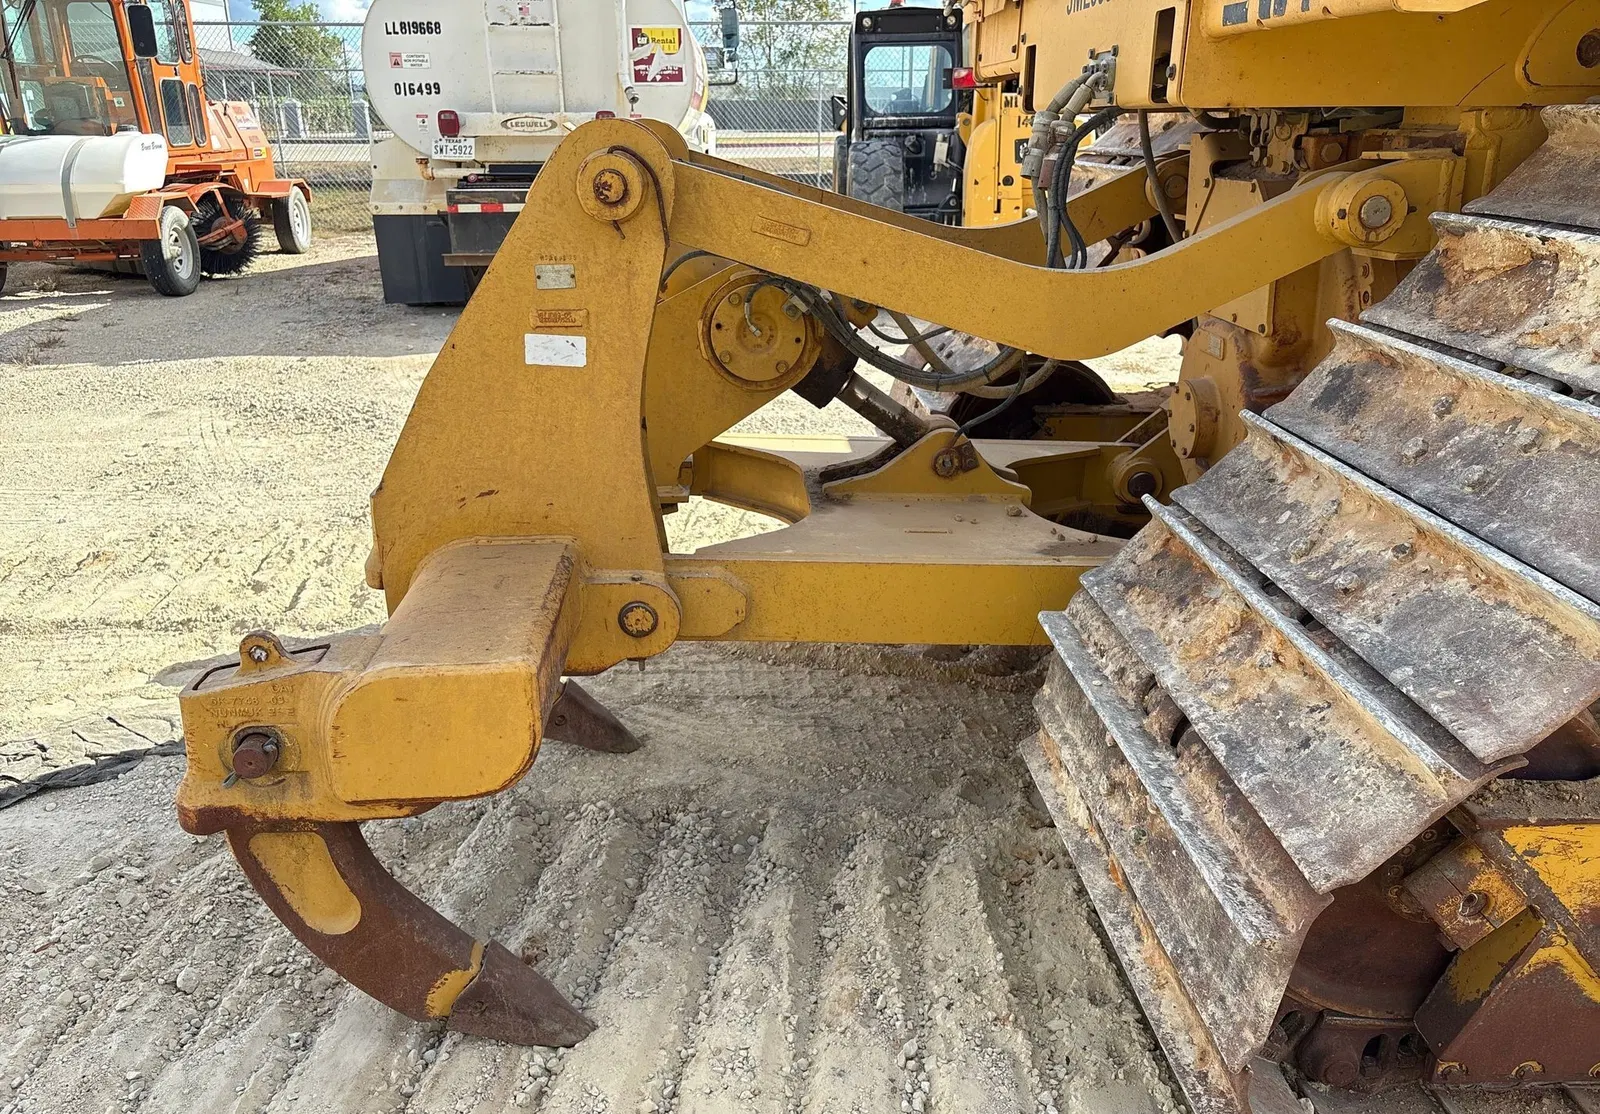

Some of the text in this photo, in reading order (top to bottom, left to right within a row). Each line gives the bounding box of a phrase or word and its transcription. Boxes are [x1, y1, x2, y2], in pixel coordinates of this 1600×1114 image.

[385, 21, 442, 36] LL819668
[651, 37, 676, 45] Rental
[394, 81, 441, 96] 016499
